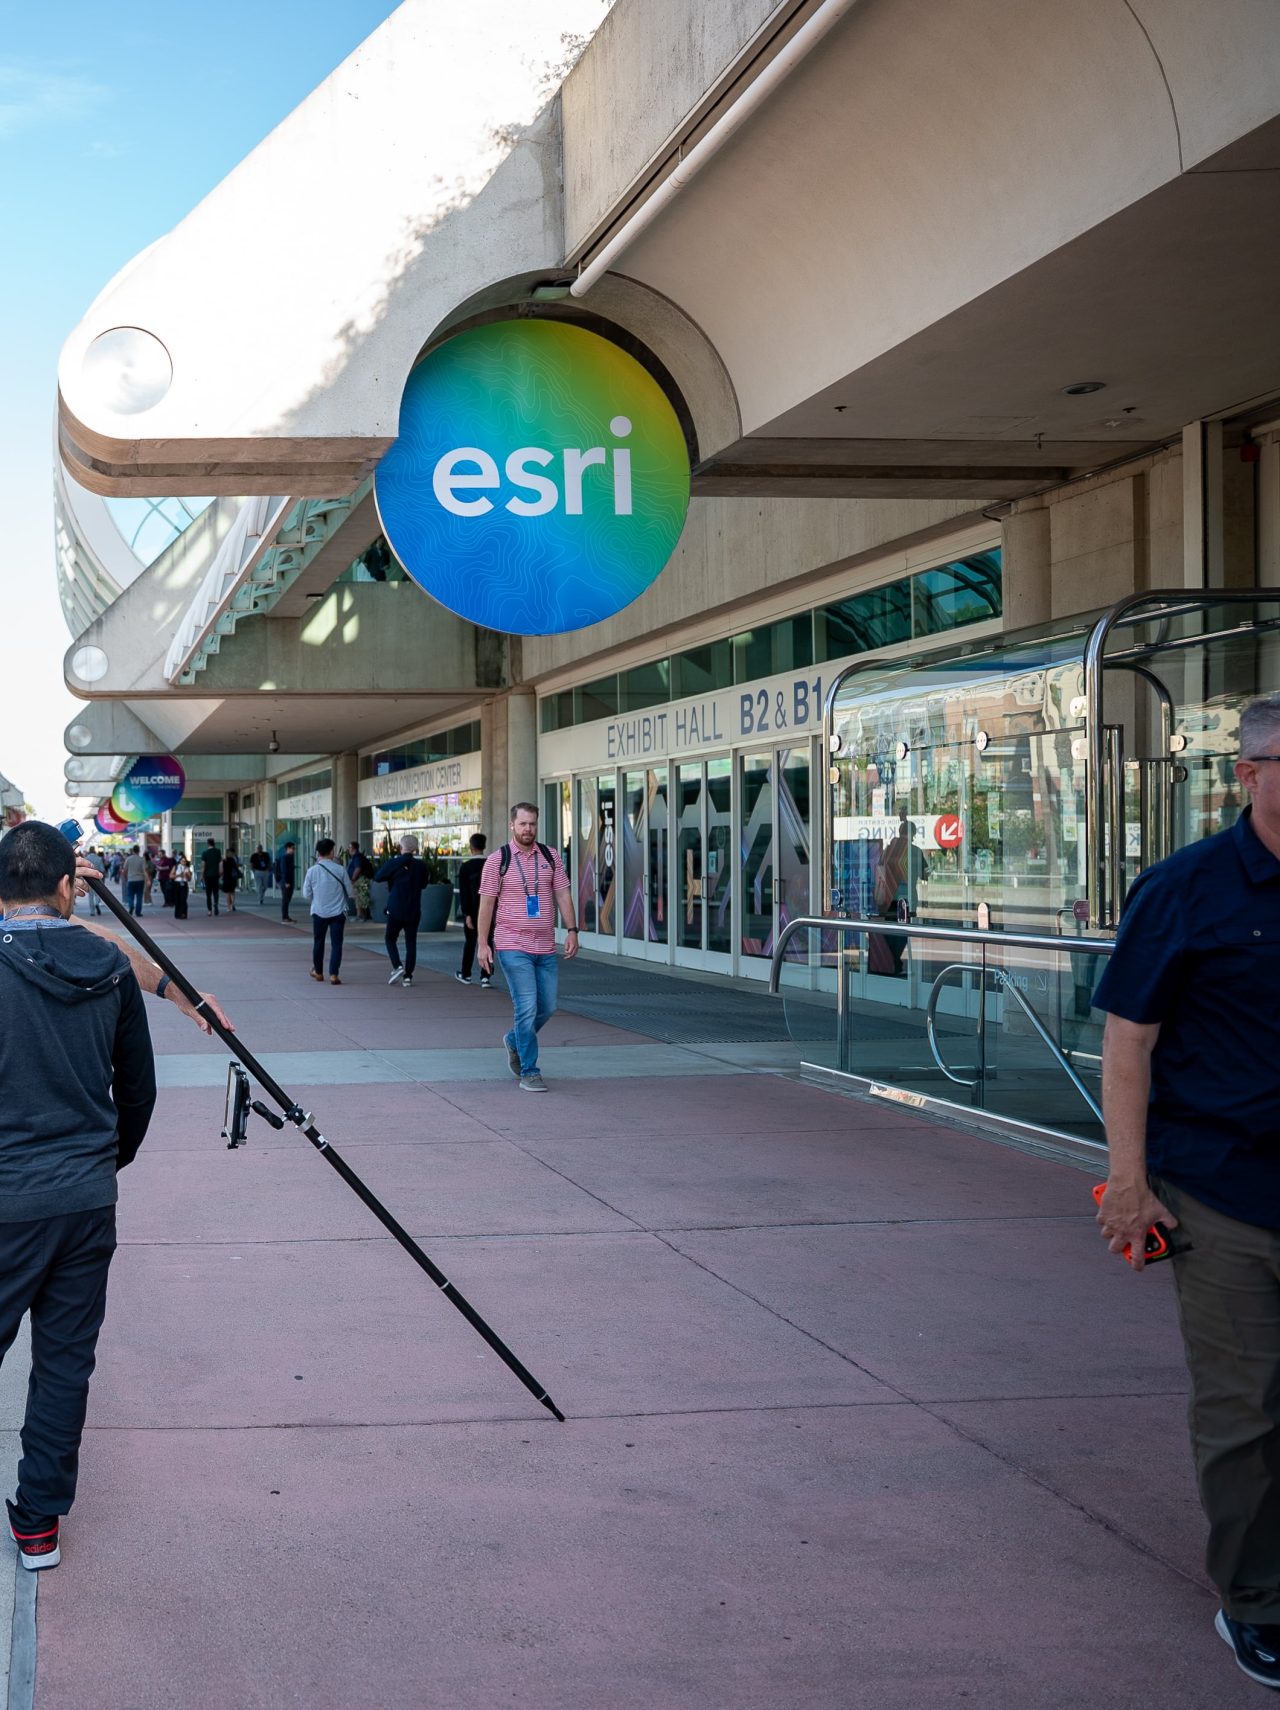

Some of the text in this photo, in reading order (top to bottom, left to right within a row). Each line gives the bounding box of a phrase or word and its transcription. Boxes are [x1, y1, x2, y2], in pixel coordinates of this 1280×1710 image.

[432, 415, 633, 517] esri
[607, 676, 822, 758] EXHIBIT HALL B2 & B1
[130, 776, 180, 785] WELCOME
[436, 763, 461, 789] CENTER
[601, 802, 613, 867] esri
